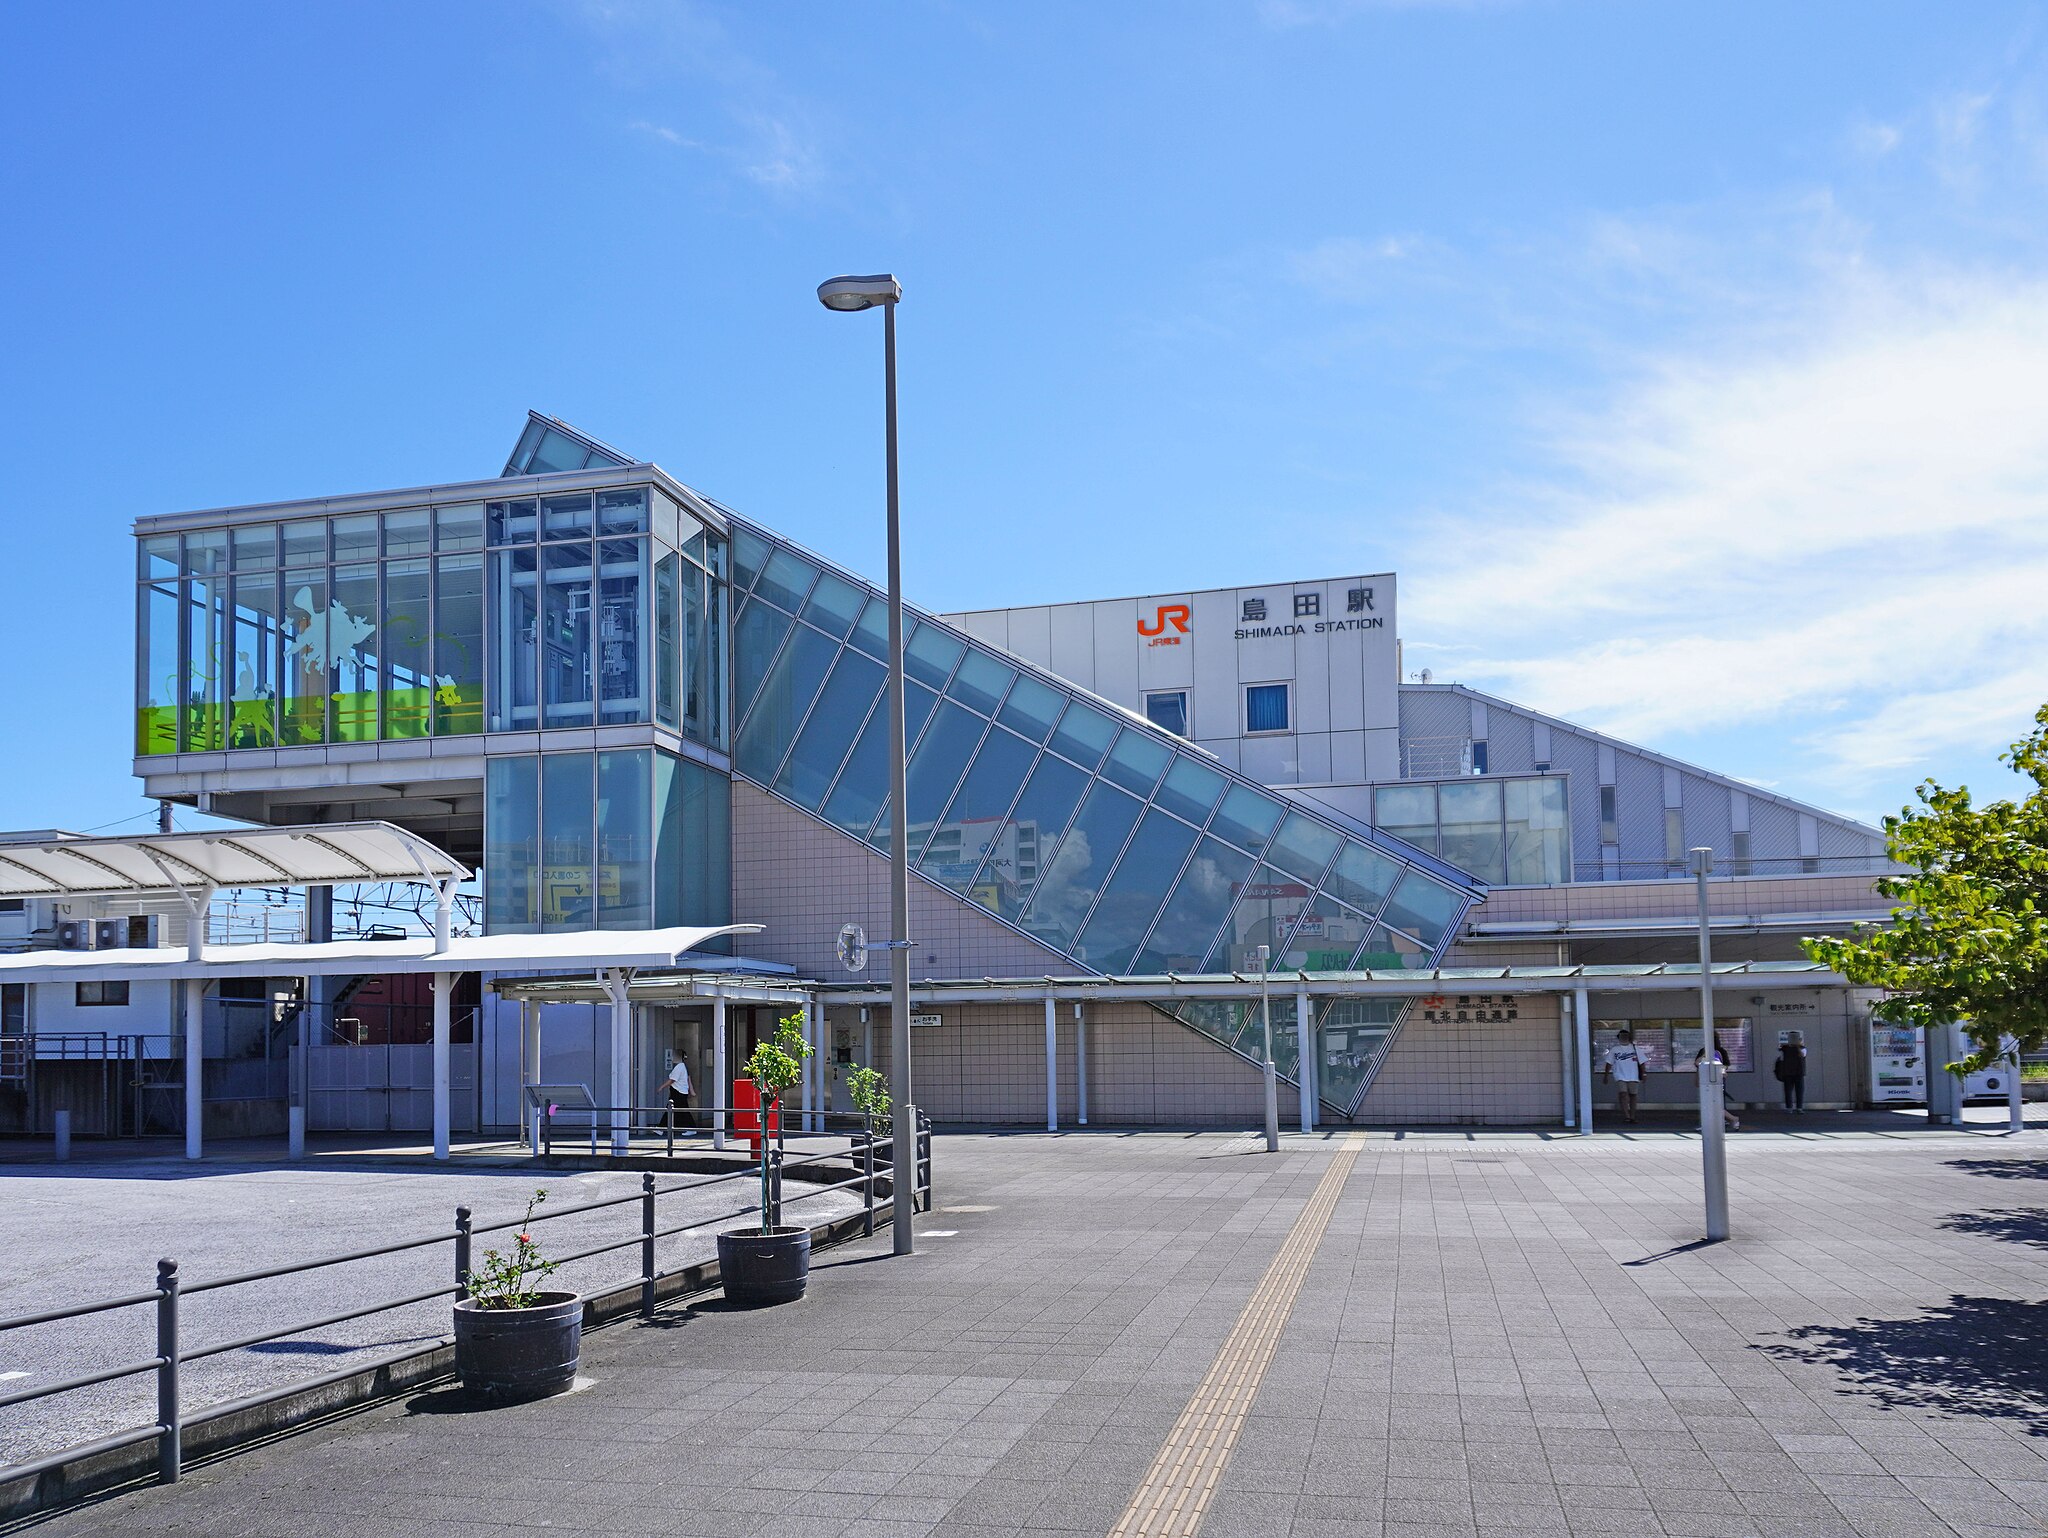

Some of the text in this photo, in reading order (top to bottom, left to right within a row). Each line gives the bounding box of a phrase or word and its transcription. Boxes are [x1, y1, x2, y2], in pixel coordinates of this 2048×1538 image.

[1241, 587, 1374, 622] 島田駅
[1137, 604, 1191, 637] JR
[1234, 617, 1383, 640] SHIMADA STATION
[1424, 1009, 1518, 1020] 南北自由通路
[1770, 1003, 1807, 1011] 観光案内所
